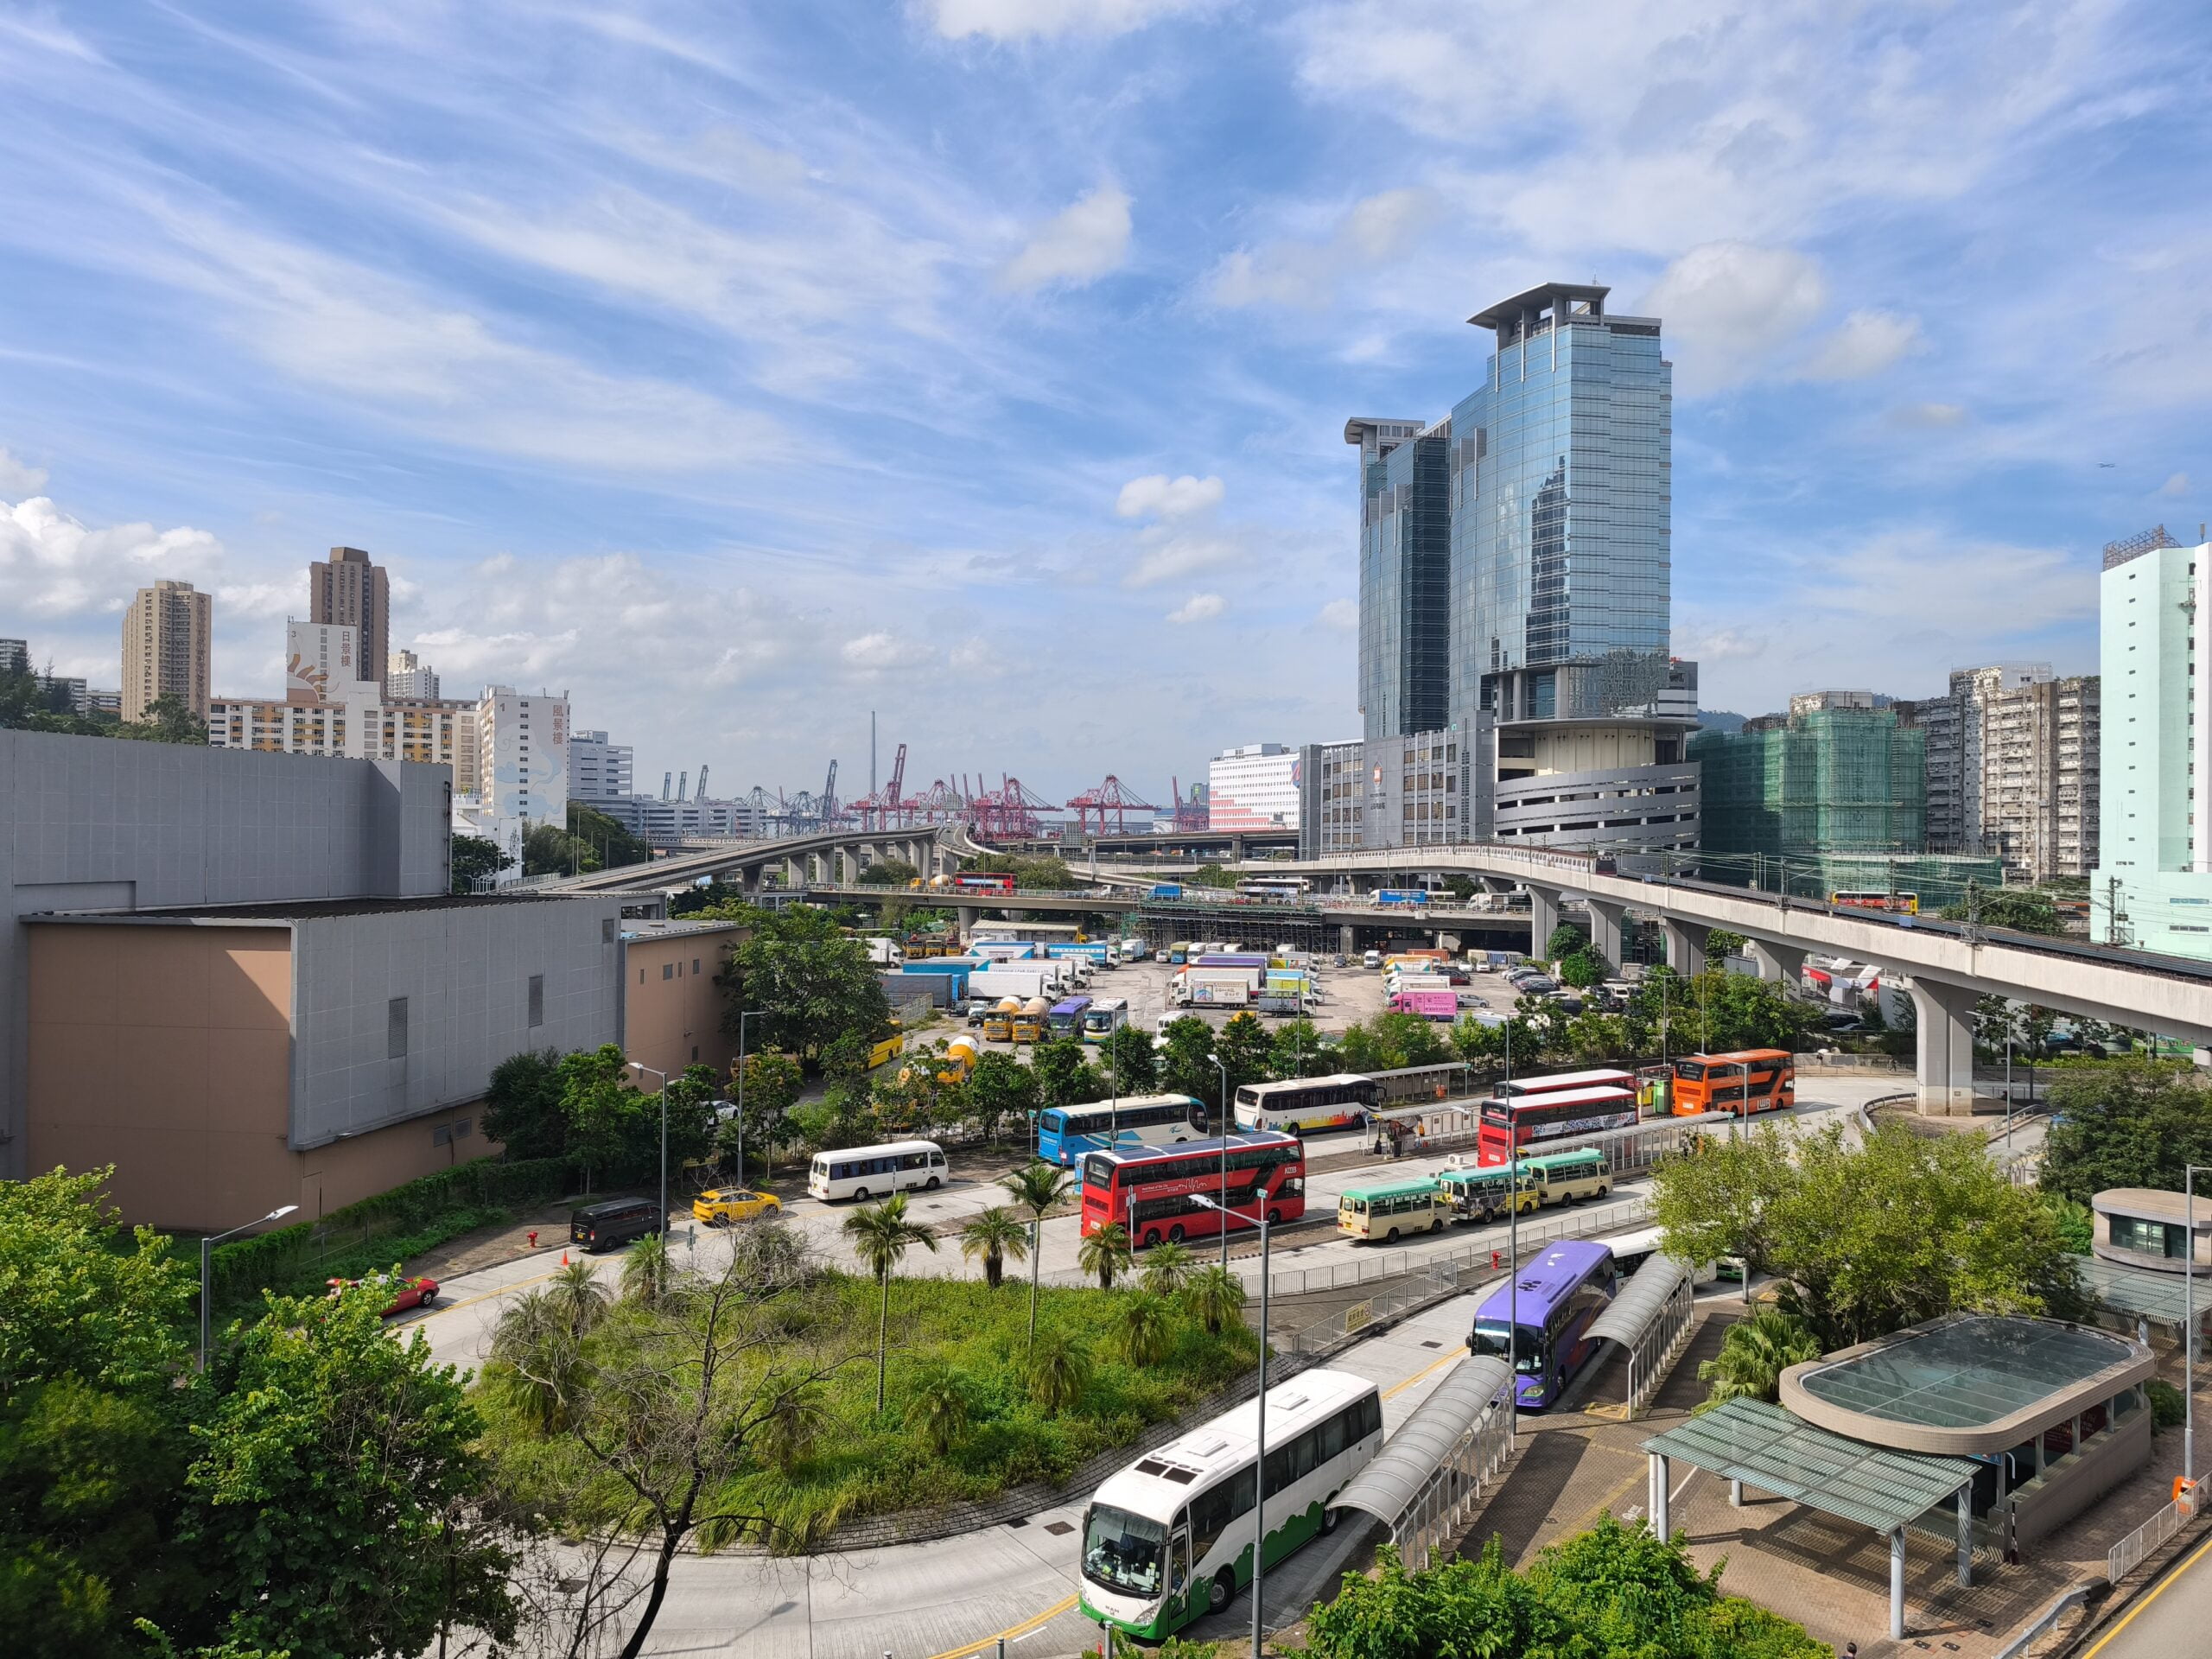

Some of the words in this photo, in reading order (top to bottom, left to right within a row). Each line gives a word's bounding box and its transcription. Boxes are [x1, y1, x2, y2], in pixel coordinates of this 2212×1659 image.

[341, 631, 351, 667] 日景樓
[500, 702, 505, 712] 1
[553, 705, 563, 745] 風景樓
